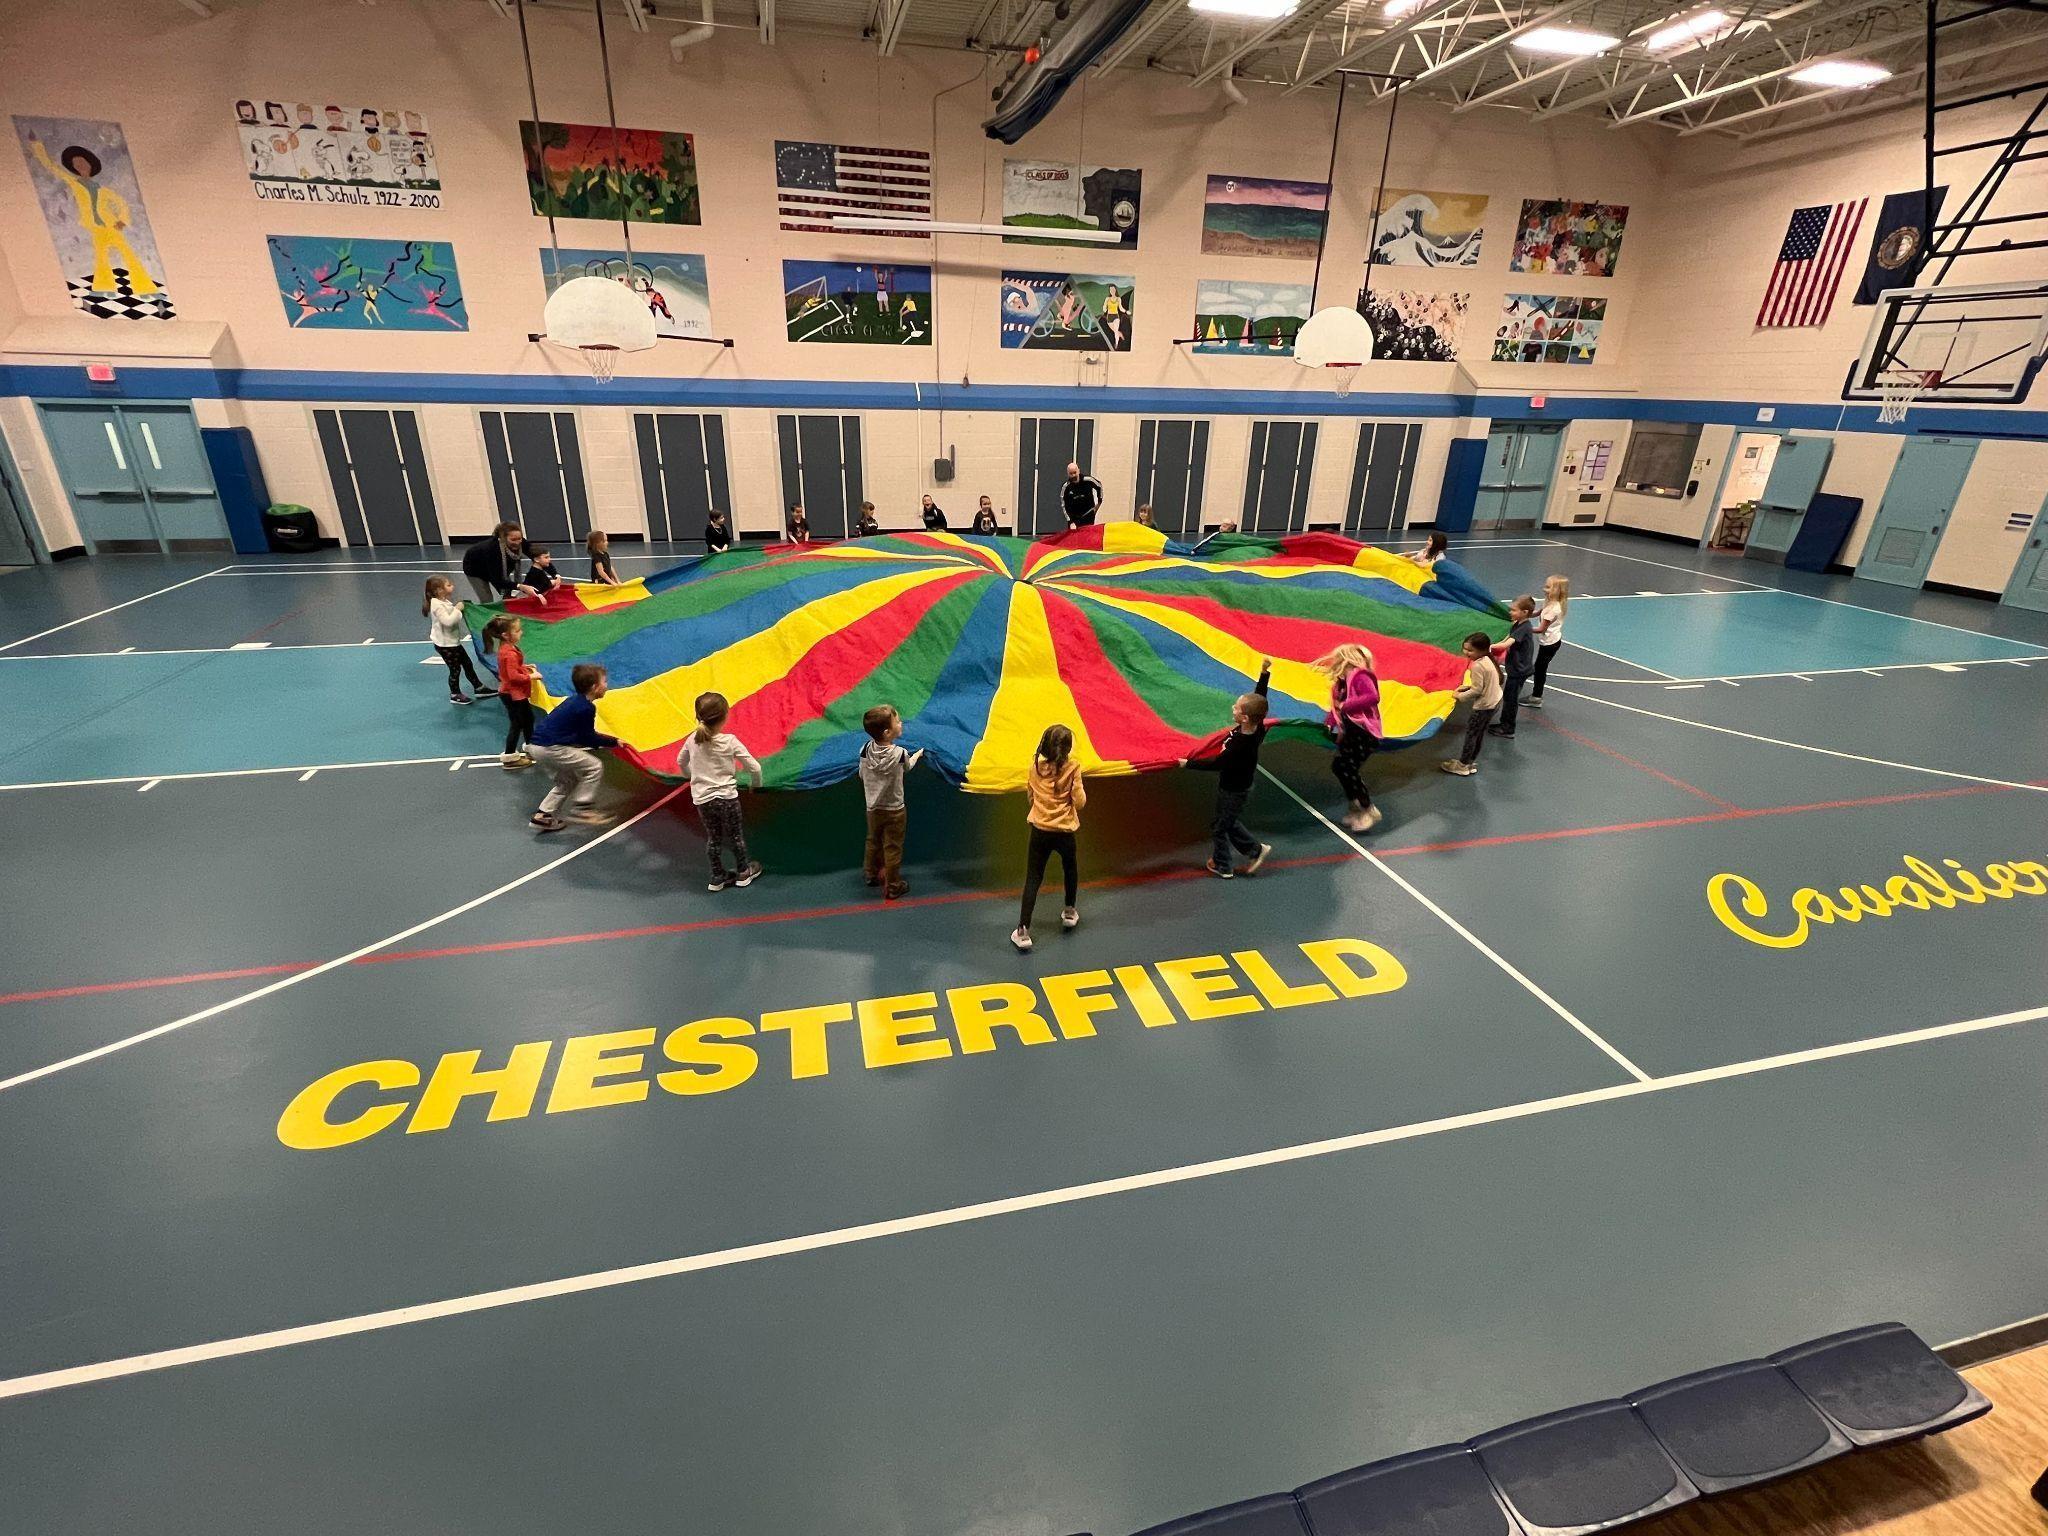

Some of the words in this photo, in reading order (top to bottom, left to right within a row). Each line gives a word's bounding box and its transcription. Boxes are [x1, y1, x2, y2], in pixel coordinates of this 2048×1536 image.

[254, 181, 305, 201] Charles
[307, 184, 323, 201] M.
[326, 185, 370, 205] Schulz
[1707, 854, 2048, 949] Cavalier
[277, 938, 1409, 1151] CHESTERFIELD
